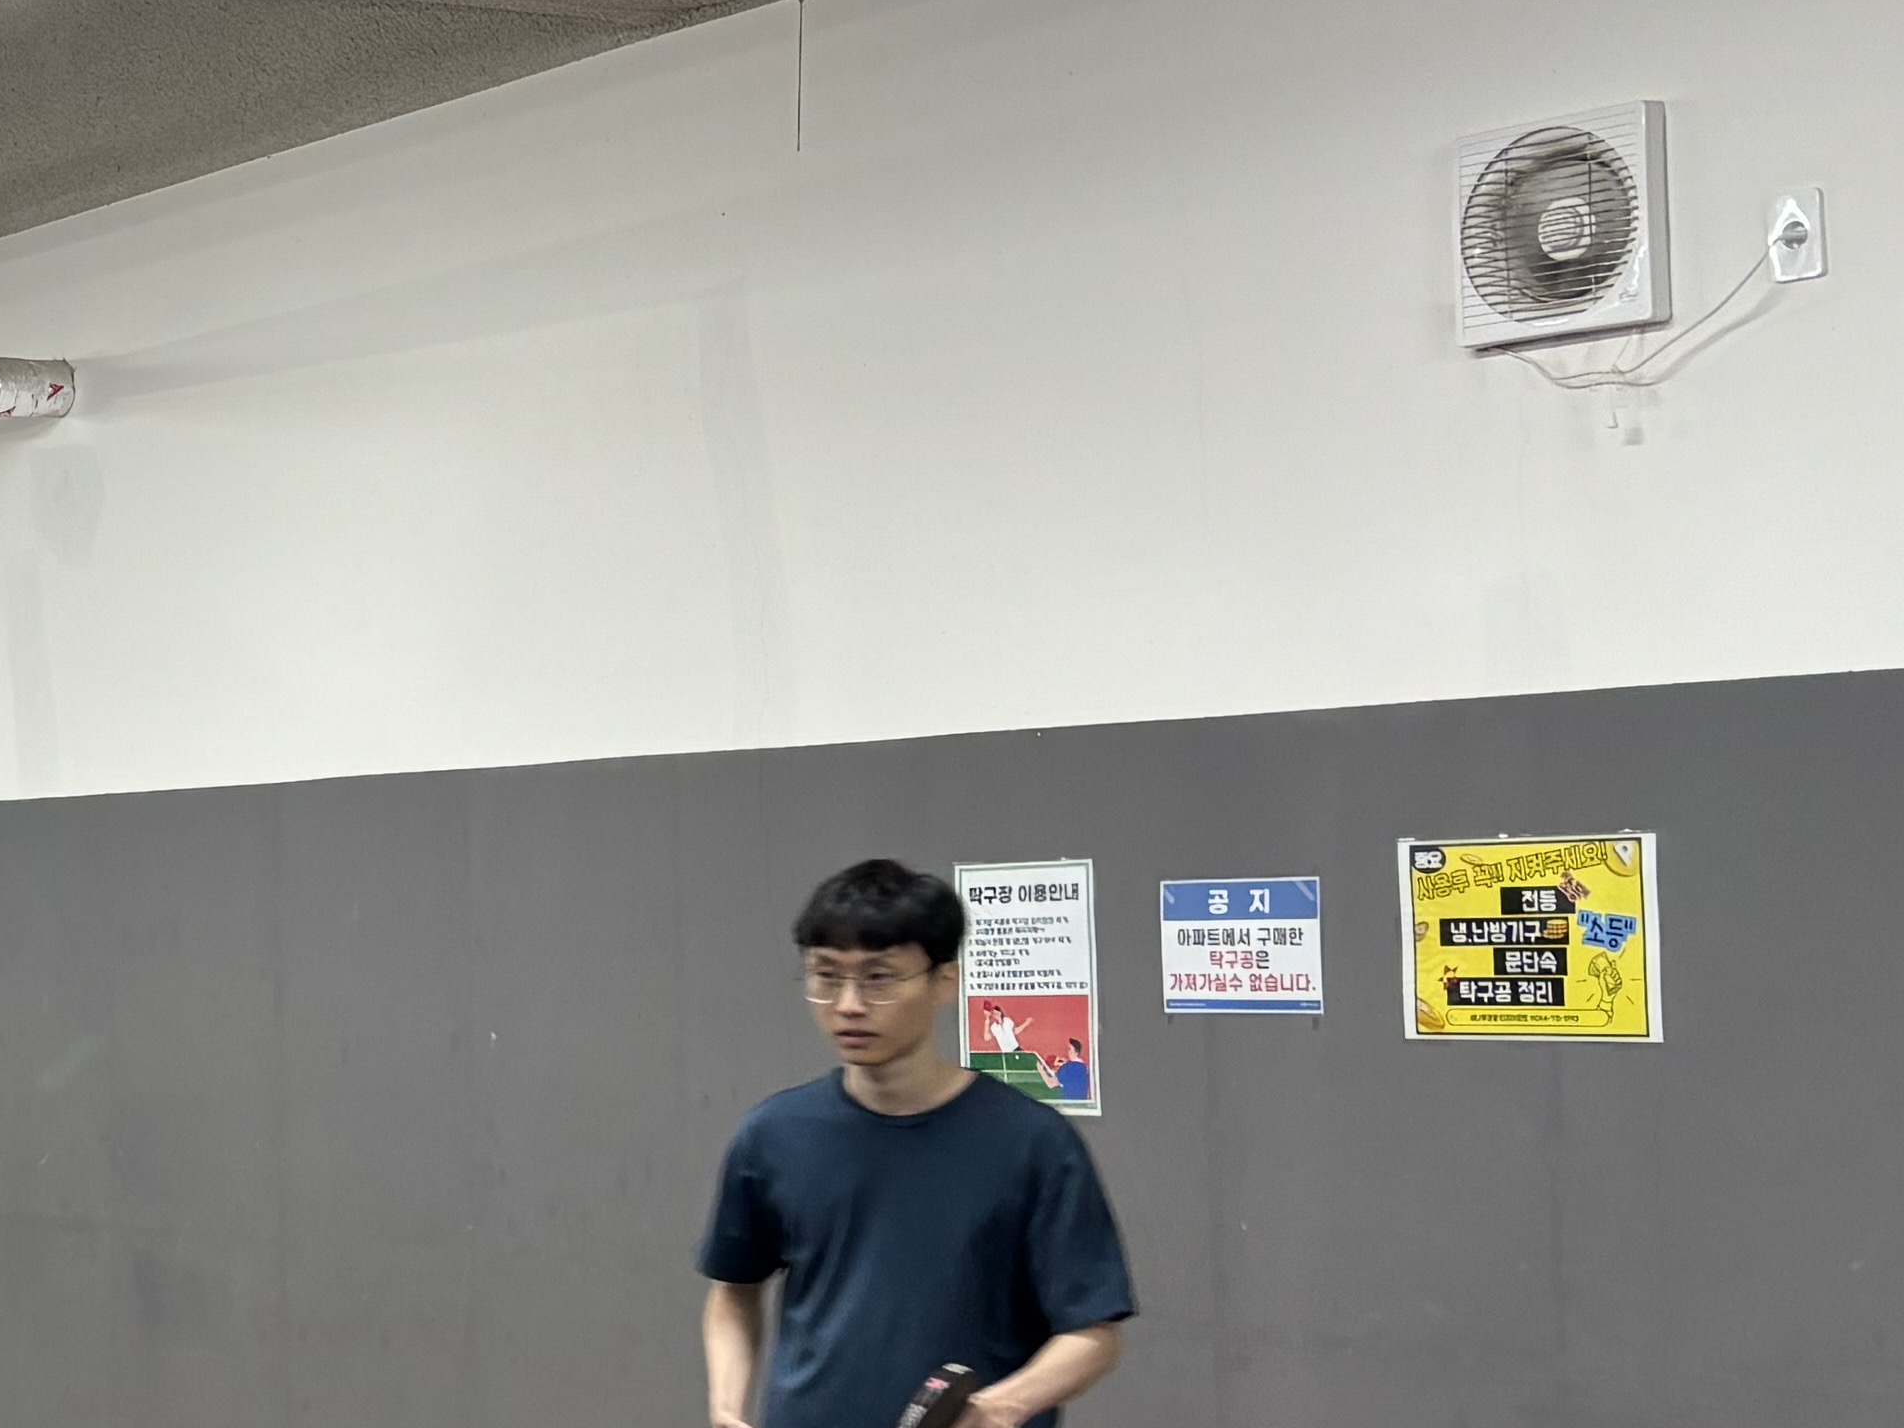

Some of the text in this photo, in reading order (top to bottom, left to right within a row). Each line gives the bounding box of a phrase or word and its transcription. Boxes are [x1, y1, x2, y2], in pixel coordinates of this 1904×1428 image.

[969, 883, 1079, 905] 탁구장 이용안내
[1417, 869, 1470, 900] 사용후
[1522, 890, 1557, 912] 전등
[1177, 927, 1304, 946] 아파트에서 구매한
[1209, 950, 1270, 969] 탁구공은
[1504, 951, 1557, 973] 문단속
[1249, 973, 1316, 992] 없습니다.
[1459, 981, 1553, 1004] 탁구공 정리
